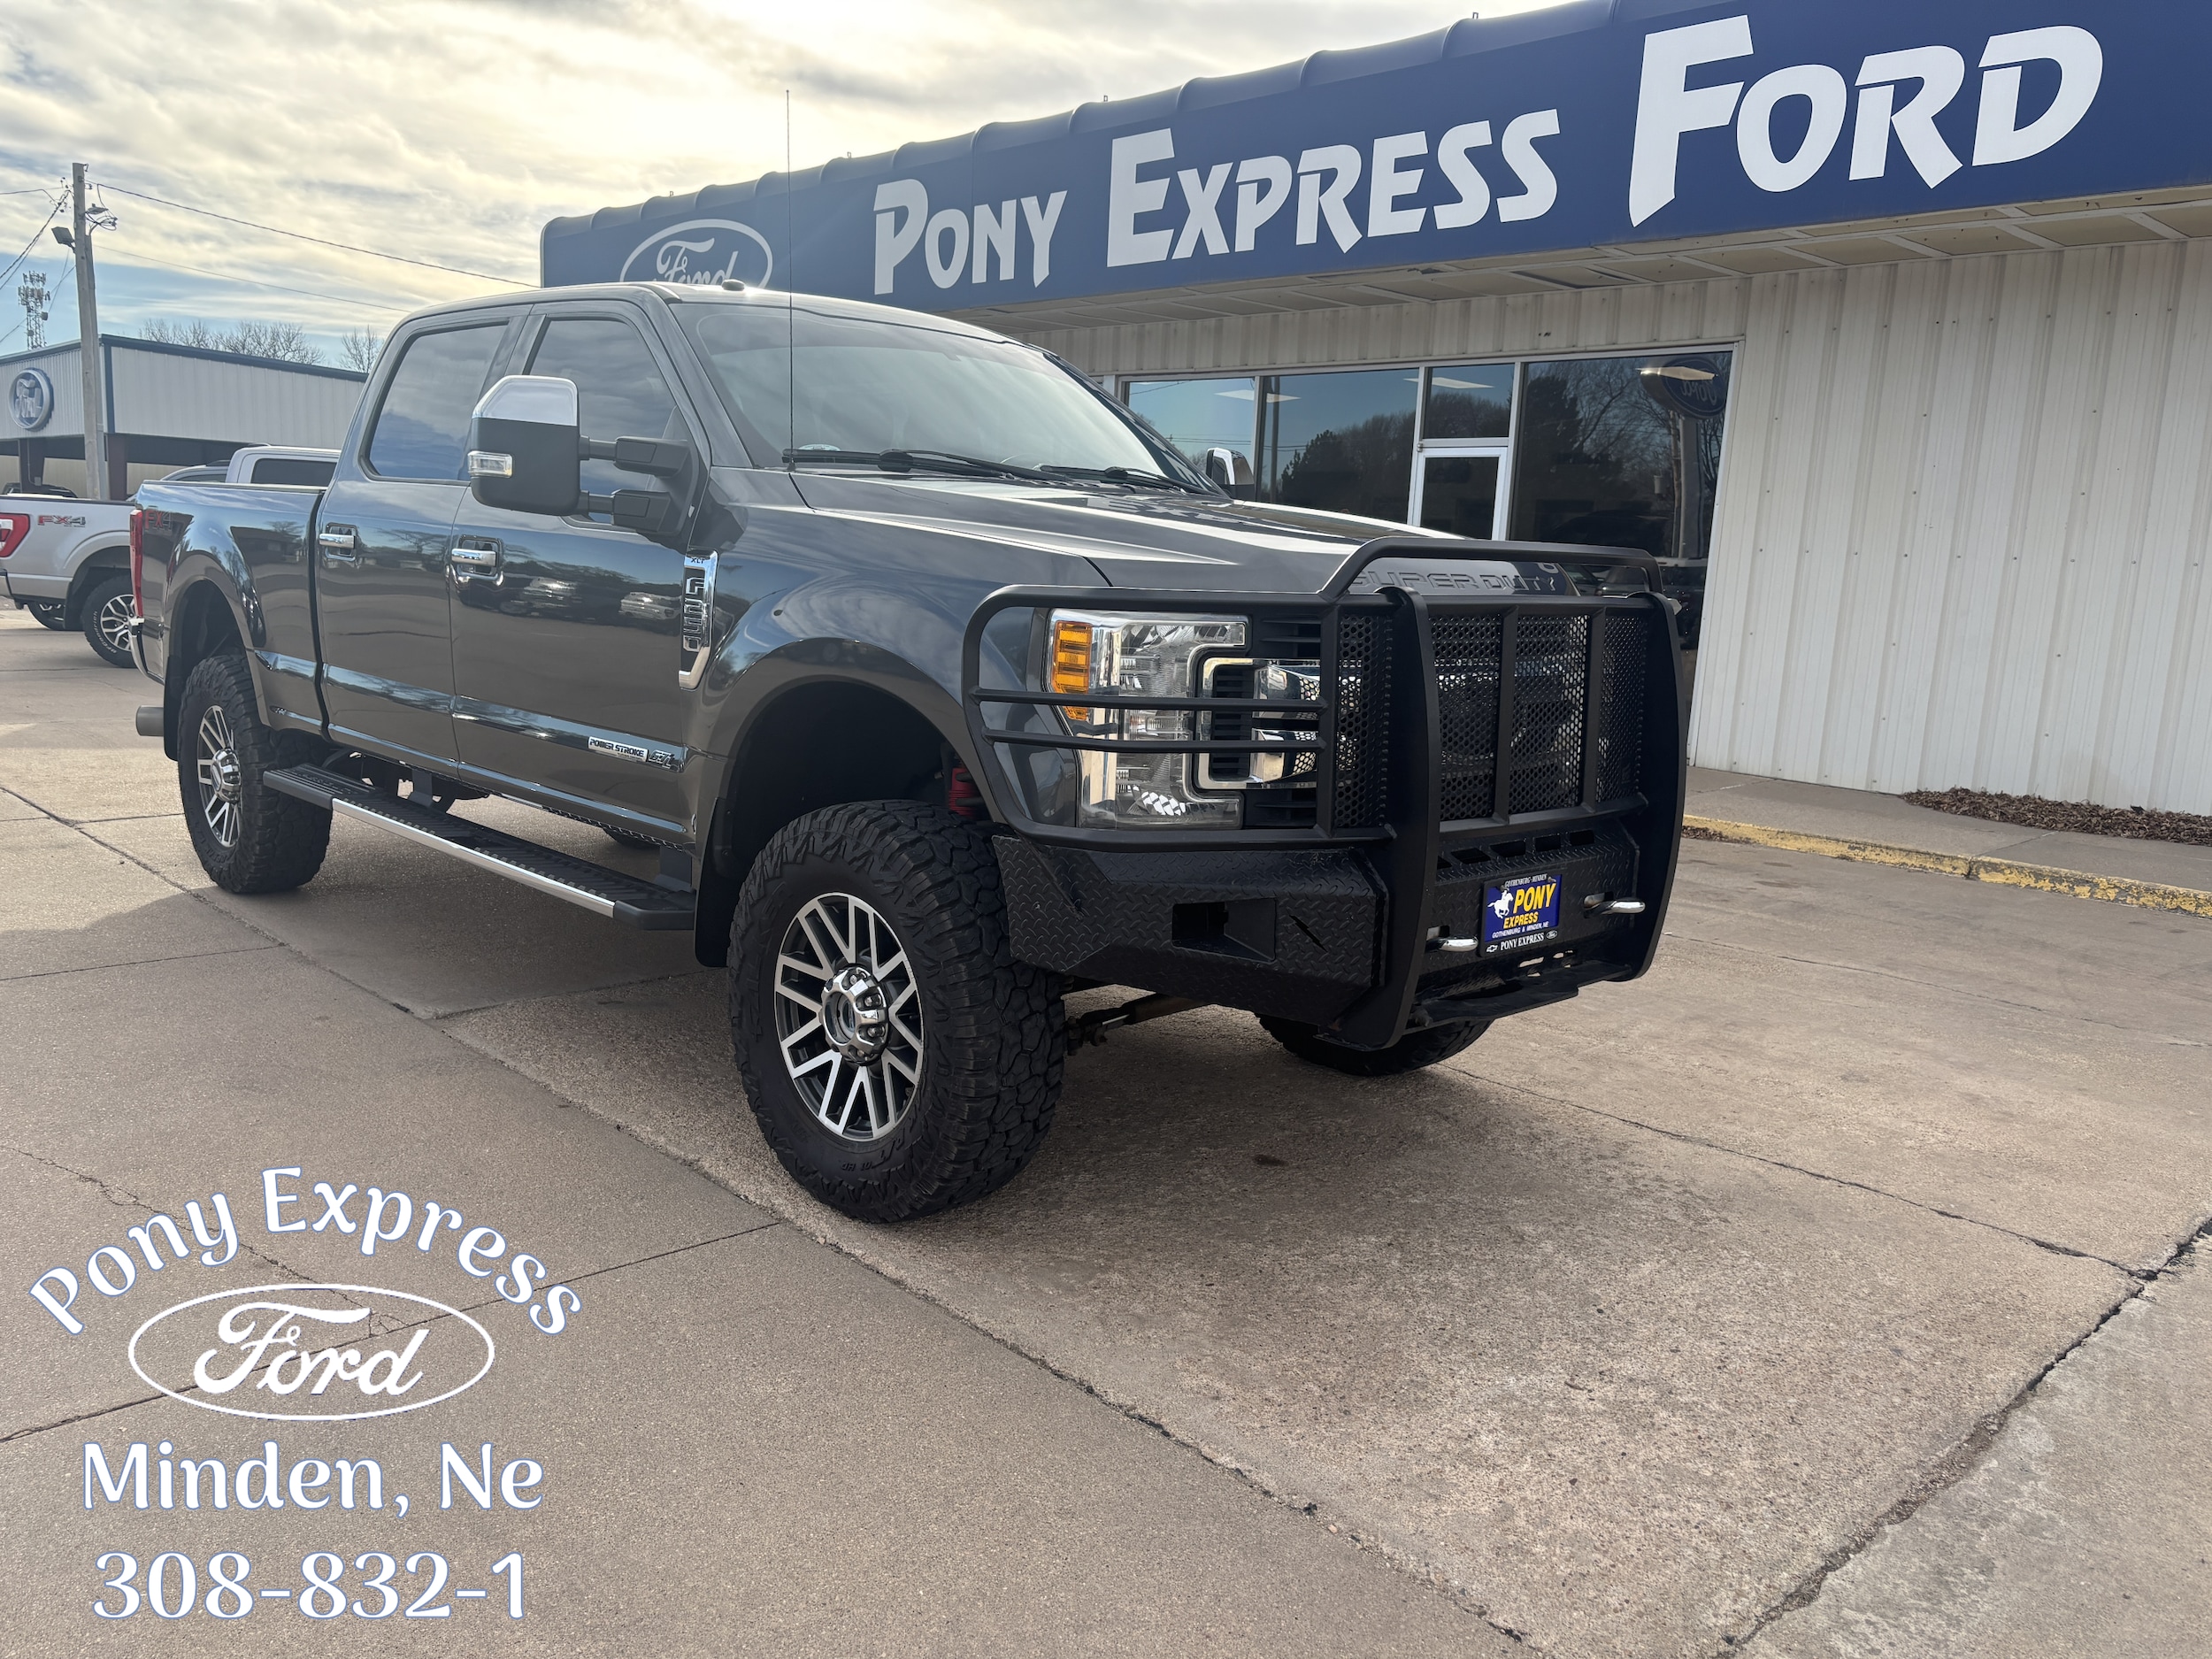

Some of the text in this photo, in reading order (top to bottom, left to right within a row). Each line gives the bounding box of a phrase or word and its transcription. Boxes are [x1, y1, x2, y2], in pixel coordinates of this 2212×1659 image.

[873, 13, 2104, 295] PONY EXPRESS FORD
[37, 515, 86, 526] FX4
[144, 505, 172, 531] FX4
[1354, 571, 1556, 591] SUPER DUTY
[589, 738, 614, 751] POWER
[614, 744, 645, 757] STROKE
[1513, 883, 1556, 914] PONY
[1503, 911, 1539, 929] EXPRESS
[1492, 927, 1521, 939] GOTHENBURG
[1500, 933, 1545, 951] PONY EXPRESS
